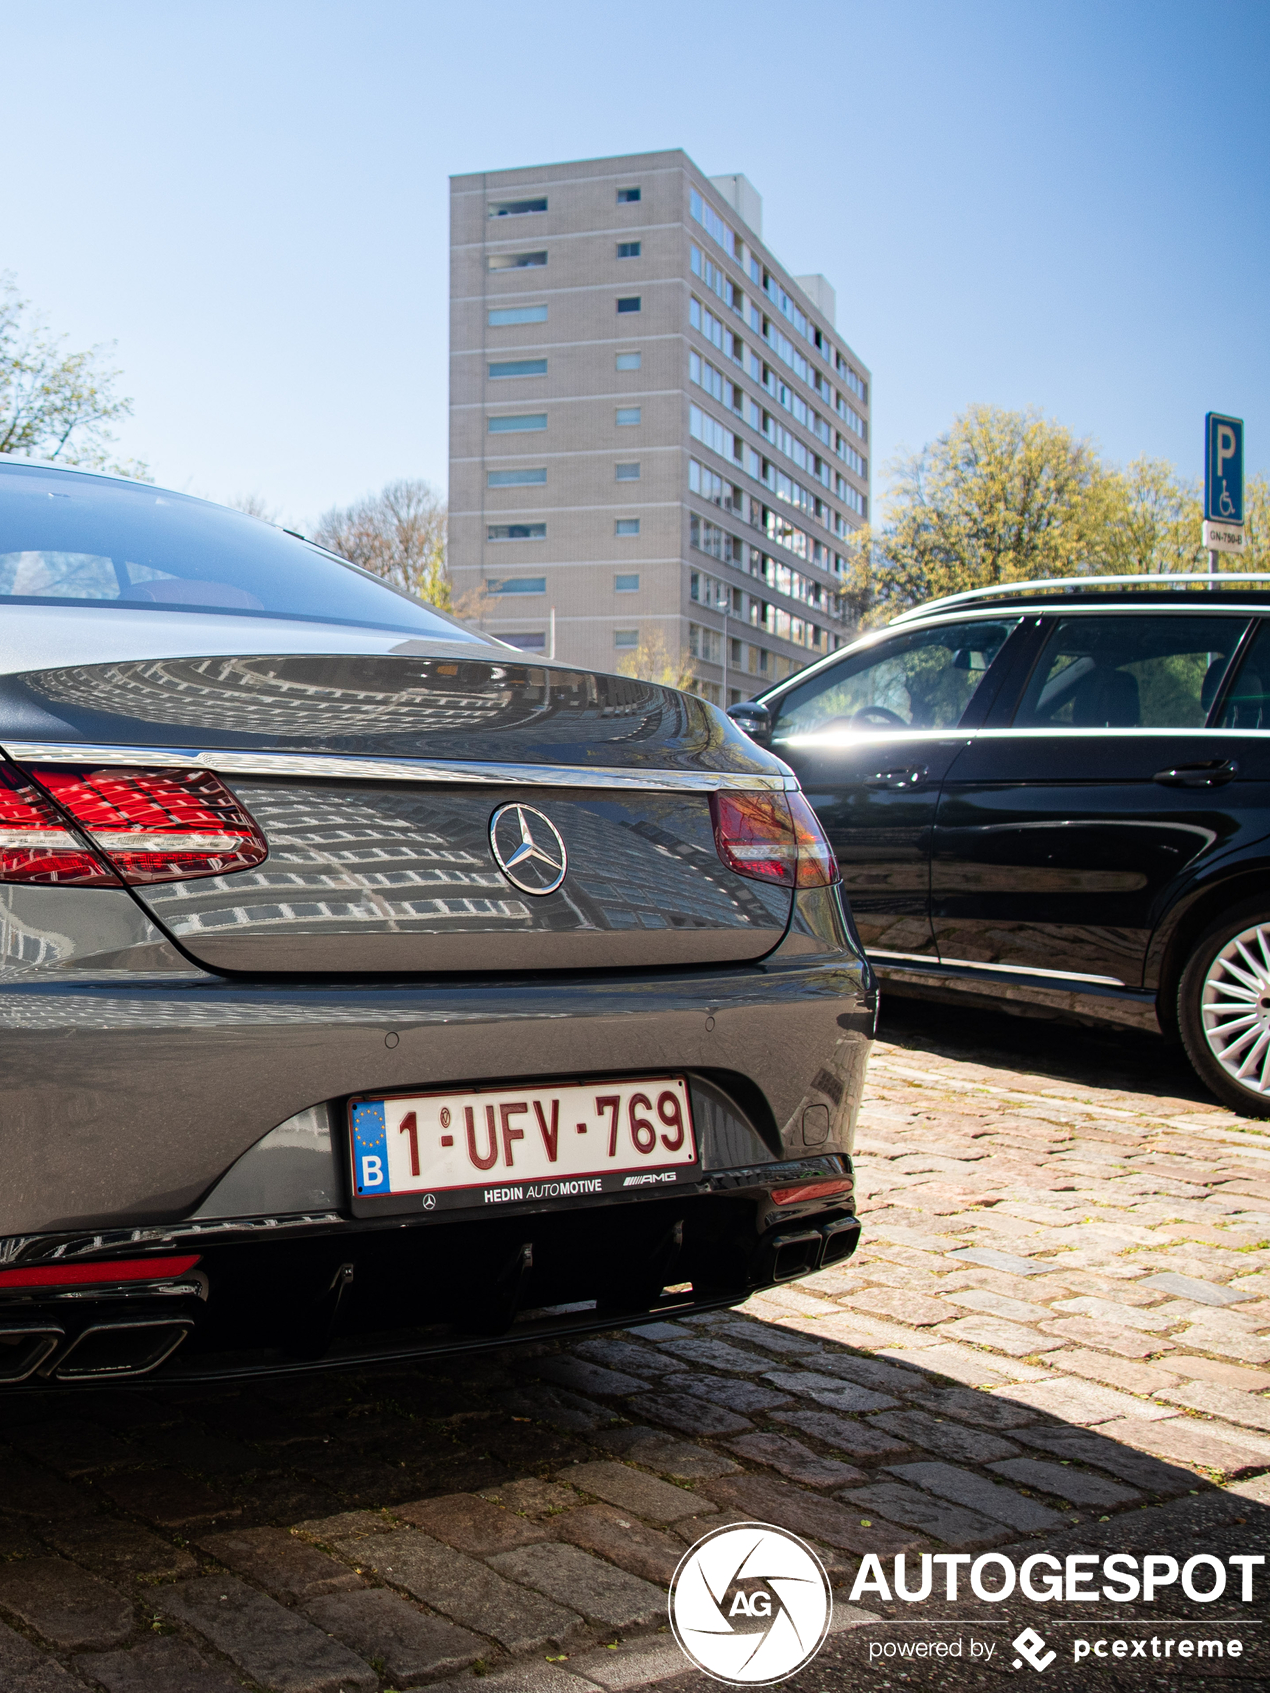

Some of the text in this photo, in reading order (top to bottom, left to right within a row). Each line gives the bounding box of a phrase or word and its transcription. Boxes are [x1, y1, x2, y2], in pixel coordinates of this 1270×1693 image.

[1217, 424, 1236, 477] P
[399, 1090, 685, 1177] 1-UFV-769
[361, 1156, 384, 1187] B
[484, 1179, 602, 1203] HEDIN AUTOMOTIVE
